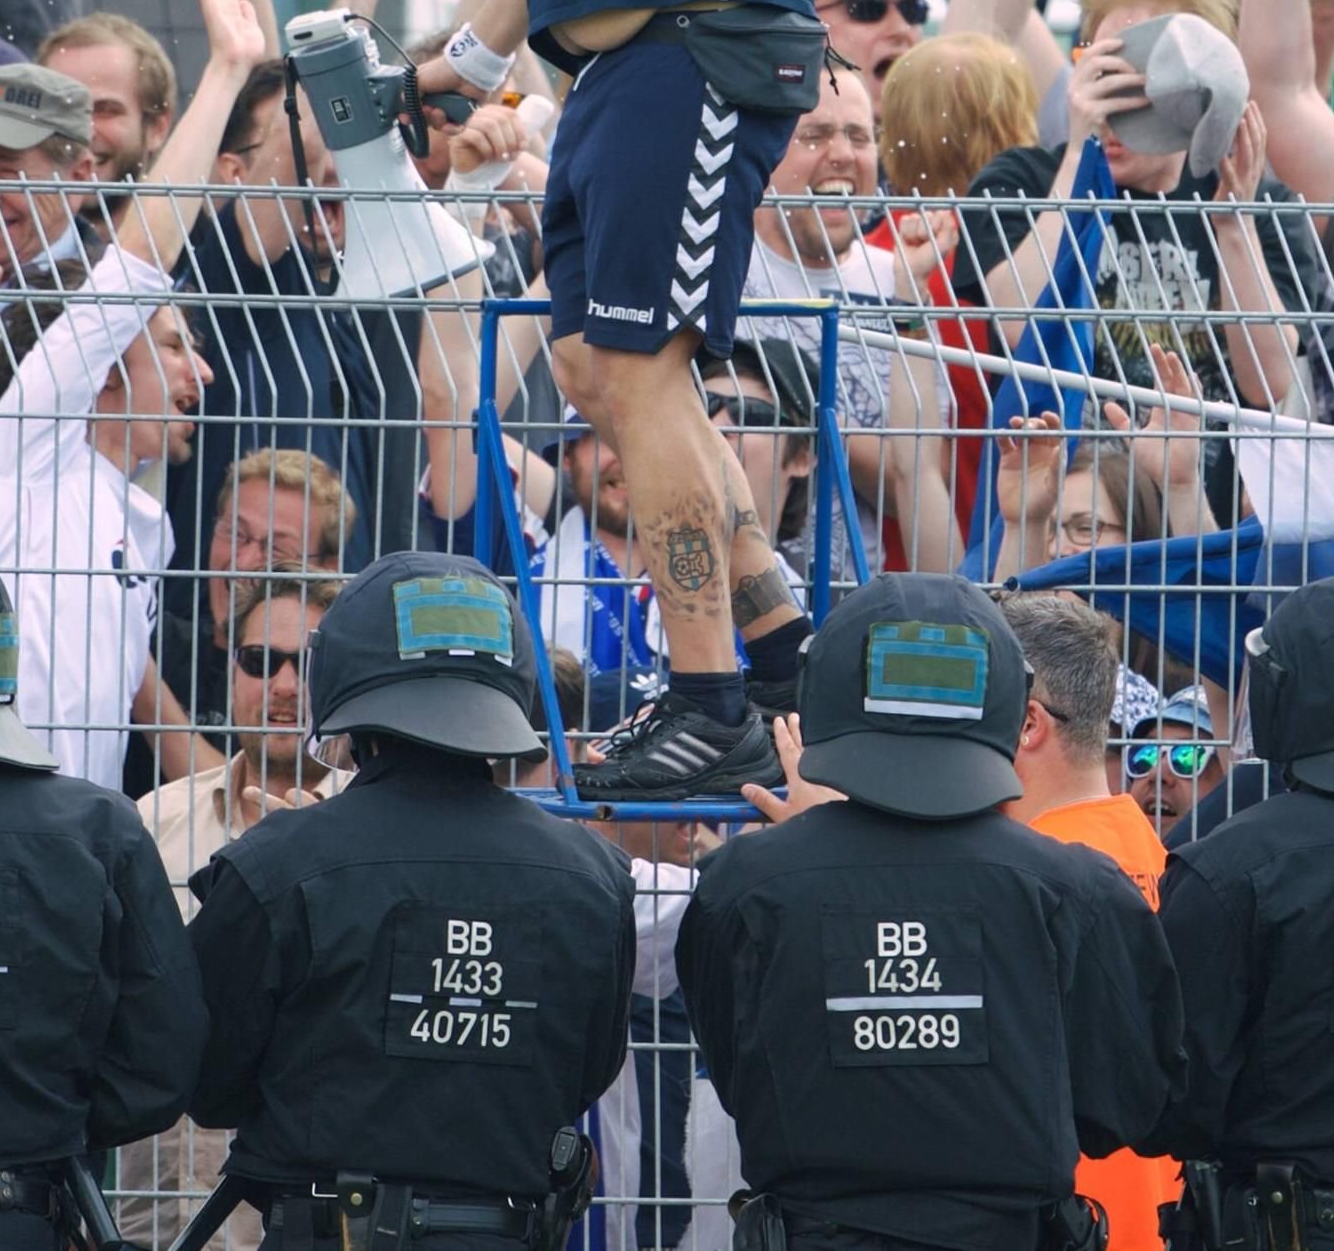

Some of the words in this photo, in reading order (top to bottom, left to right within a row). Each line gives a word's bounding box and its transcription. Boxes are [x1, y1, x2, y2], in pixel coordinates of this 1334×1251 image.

[587, 298, 654, 324] hummel
[447, 919, 493, 956] BB
[877, 921, 927, 957] BB
[431, 958, 503, 996] 1433
[864, 957, 942, 994] 1434
[410, 1009, 511, 1047] 40715
[854, 1014, 960, 1050] 80289
